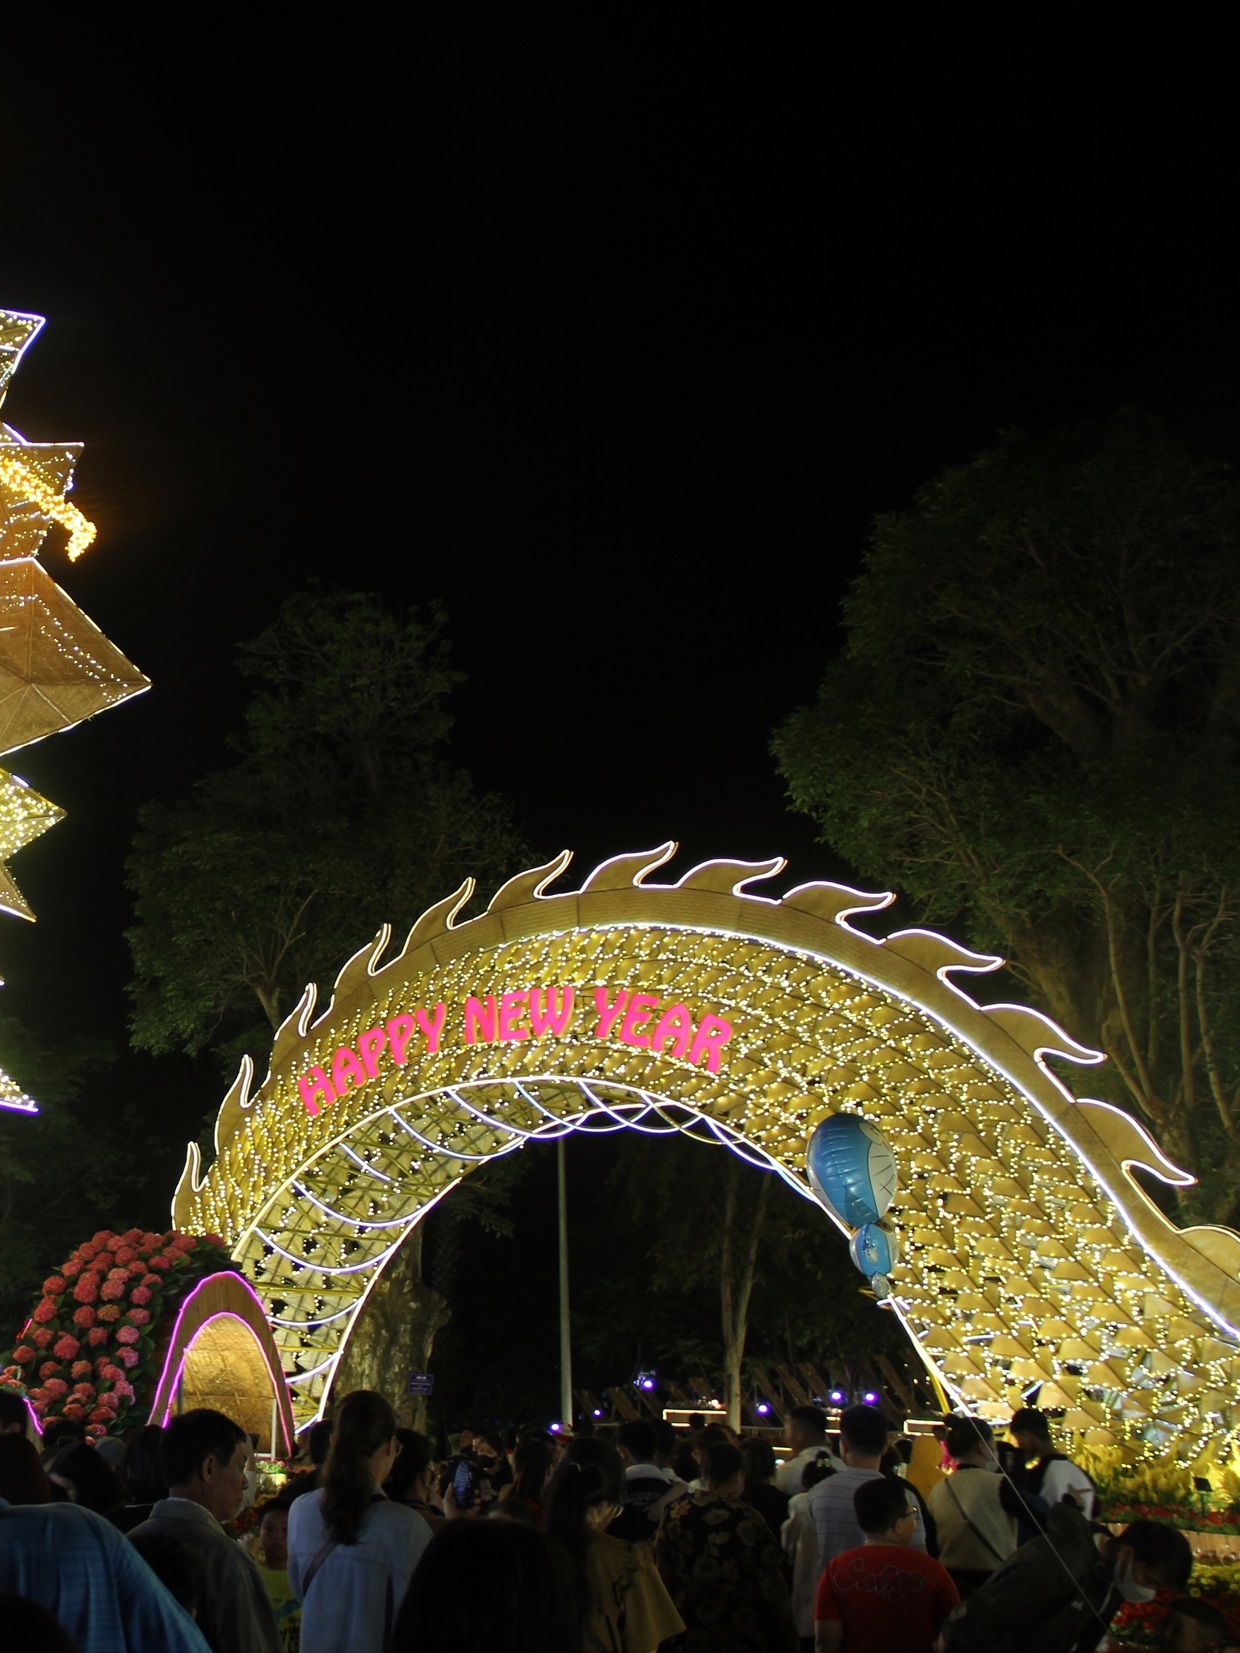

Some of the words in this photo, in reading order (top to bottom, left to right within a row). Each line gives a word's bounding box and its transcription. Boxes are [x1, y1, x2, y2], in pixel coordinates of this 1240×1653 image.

[296, 1002, 448, 1117] HAPPY
[464, 985, 574, 1045] NEW
[594, 987, 734, 1075] YEAR
